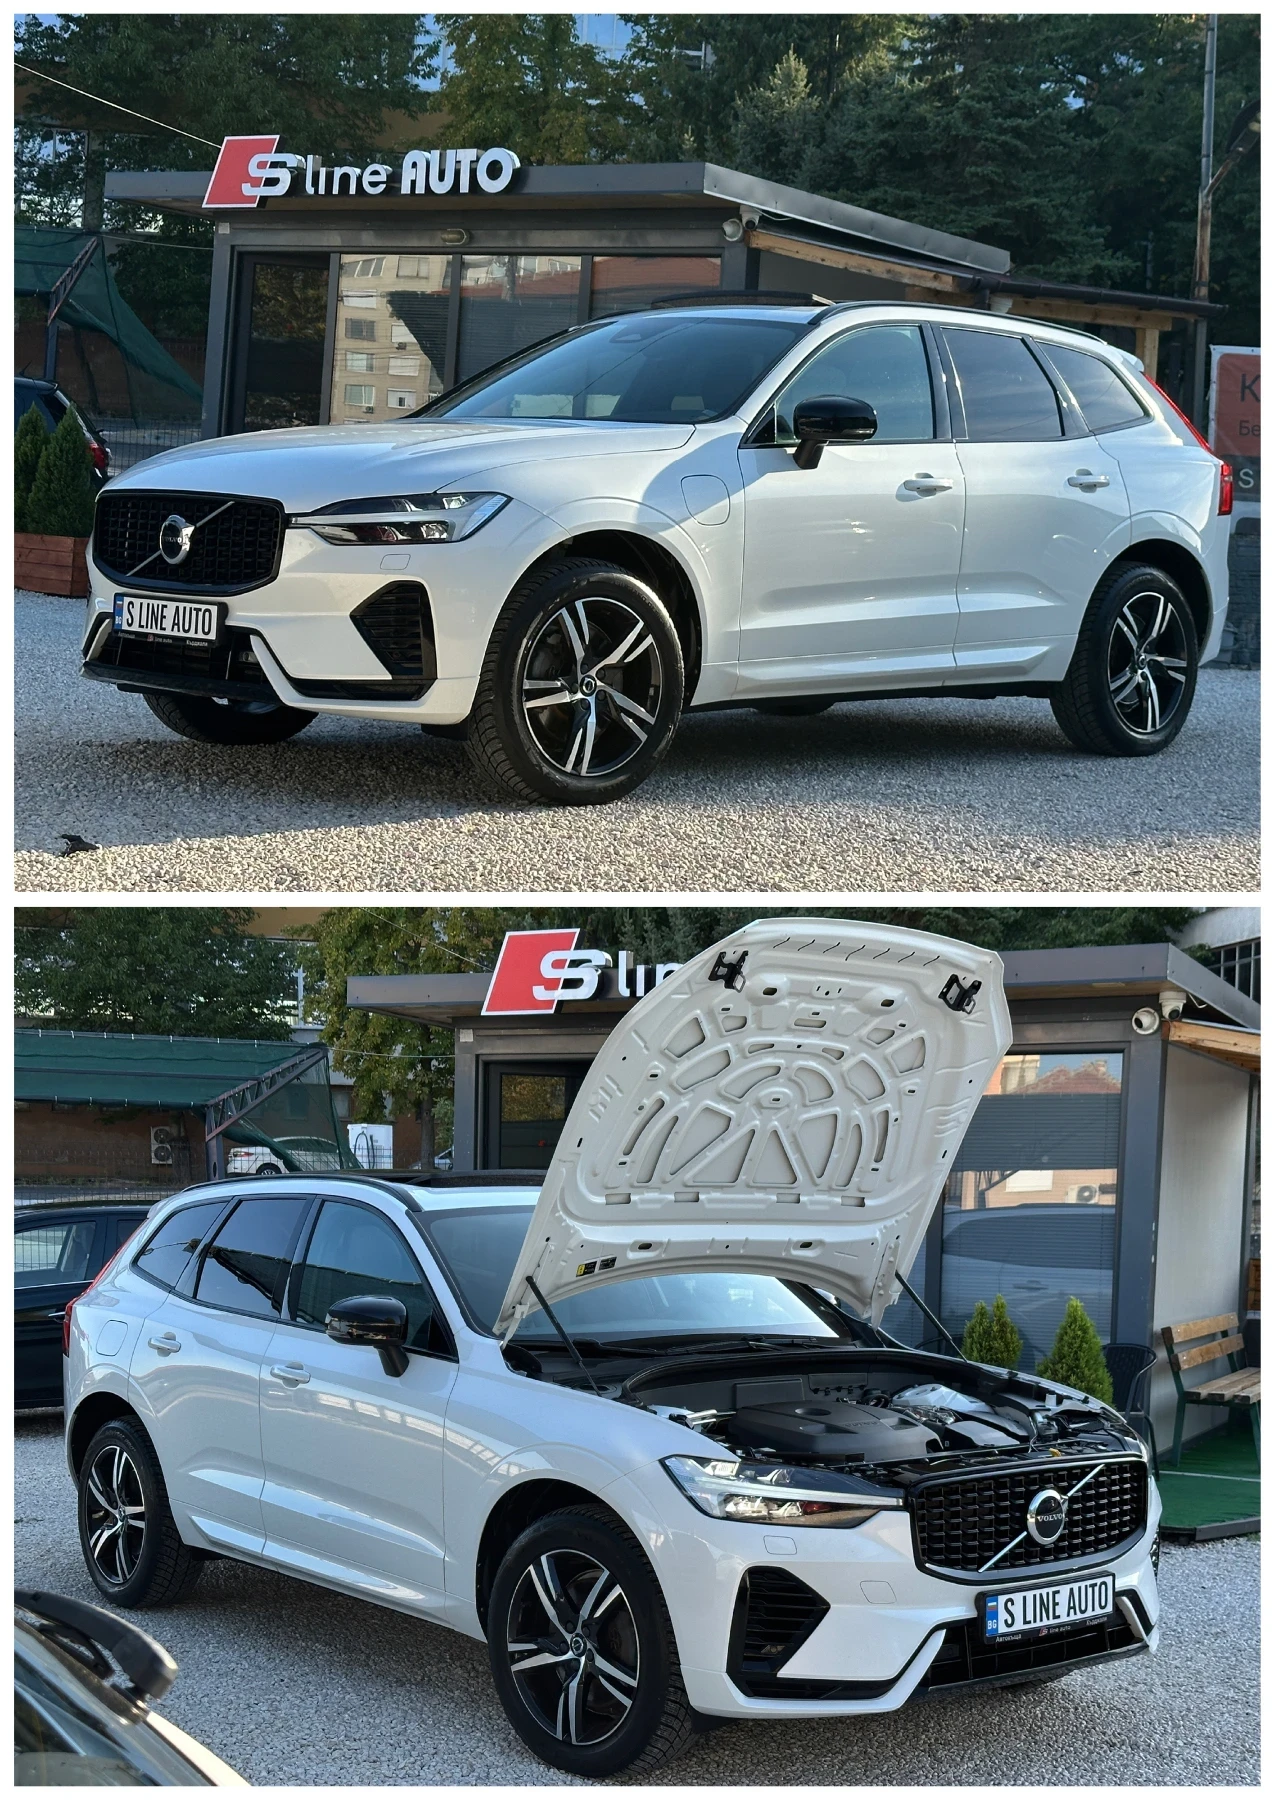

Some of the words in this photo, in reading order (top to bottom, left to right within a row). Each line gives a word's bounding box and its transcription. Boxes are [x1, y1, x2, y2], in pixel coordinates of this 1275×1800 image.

[242, 153, 299, 196] S
[305, 154, 387, 195] line
[401, 147, 516, 195] AUTO
[1238, 468, 1254, 489] S
[126, 600, 135, 628] S
[138, 602, 168, 632] LINE
[171, 605, 213, 636] AUTO
[533, 949, 608, 1000] S
[1036, 1513, 1063, 1522] VOLVO
[1003, 1597, 1015, 1628] S
[1022, 1590, 1060, 1625] LINE
[1067, 1580, 1108, 1617] AUTO
[987, 1619, 997, 1629] BG
